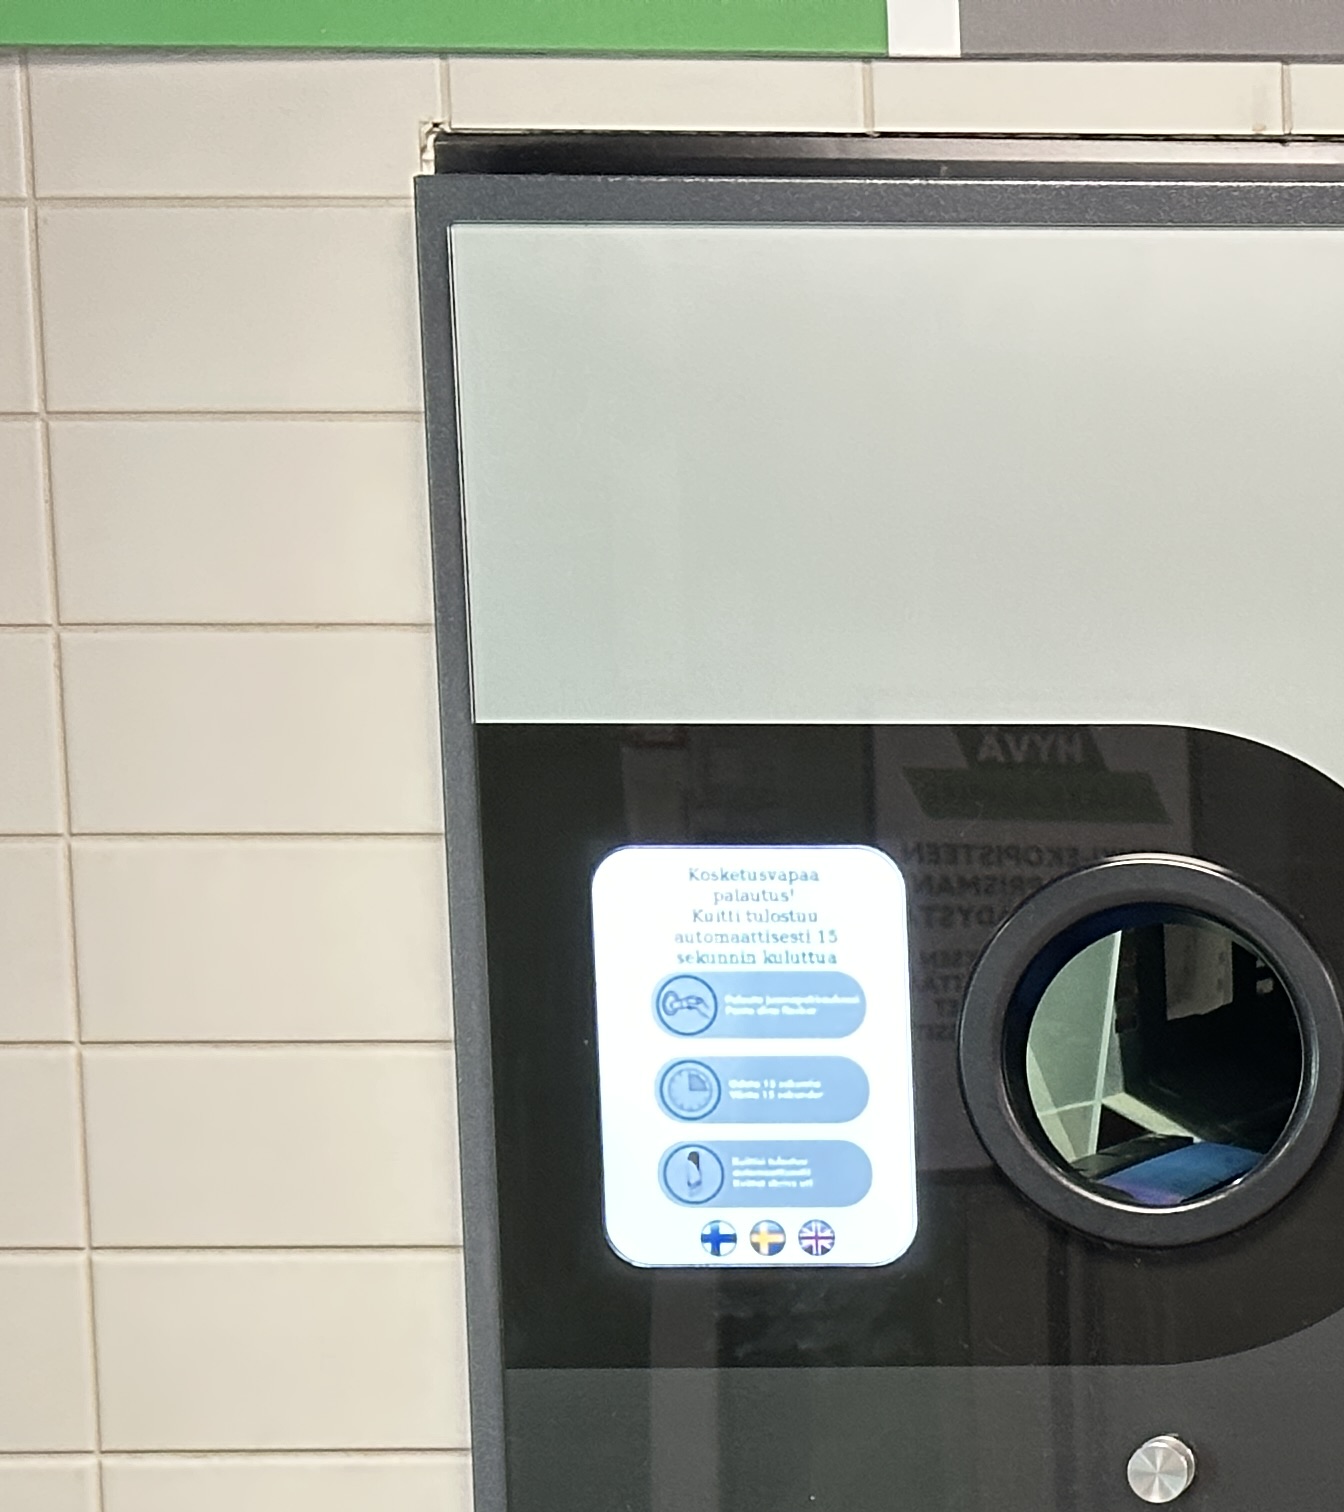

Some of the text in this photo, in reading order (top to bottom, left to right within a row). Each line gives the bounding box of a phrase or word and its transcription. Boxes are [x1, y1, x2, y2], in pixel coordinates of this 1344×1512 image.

[688, 867, 820, 885] Kosketusvapaa
[692, 909, 818, 923] Kuitti tulostuu
[674, 929, 838, 944] automaattisesti 15
[676, 950, 838, 965] sekunnin kuluttua
